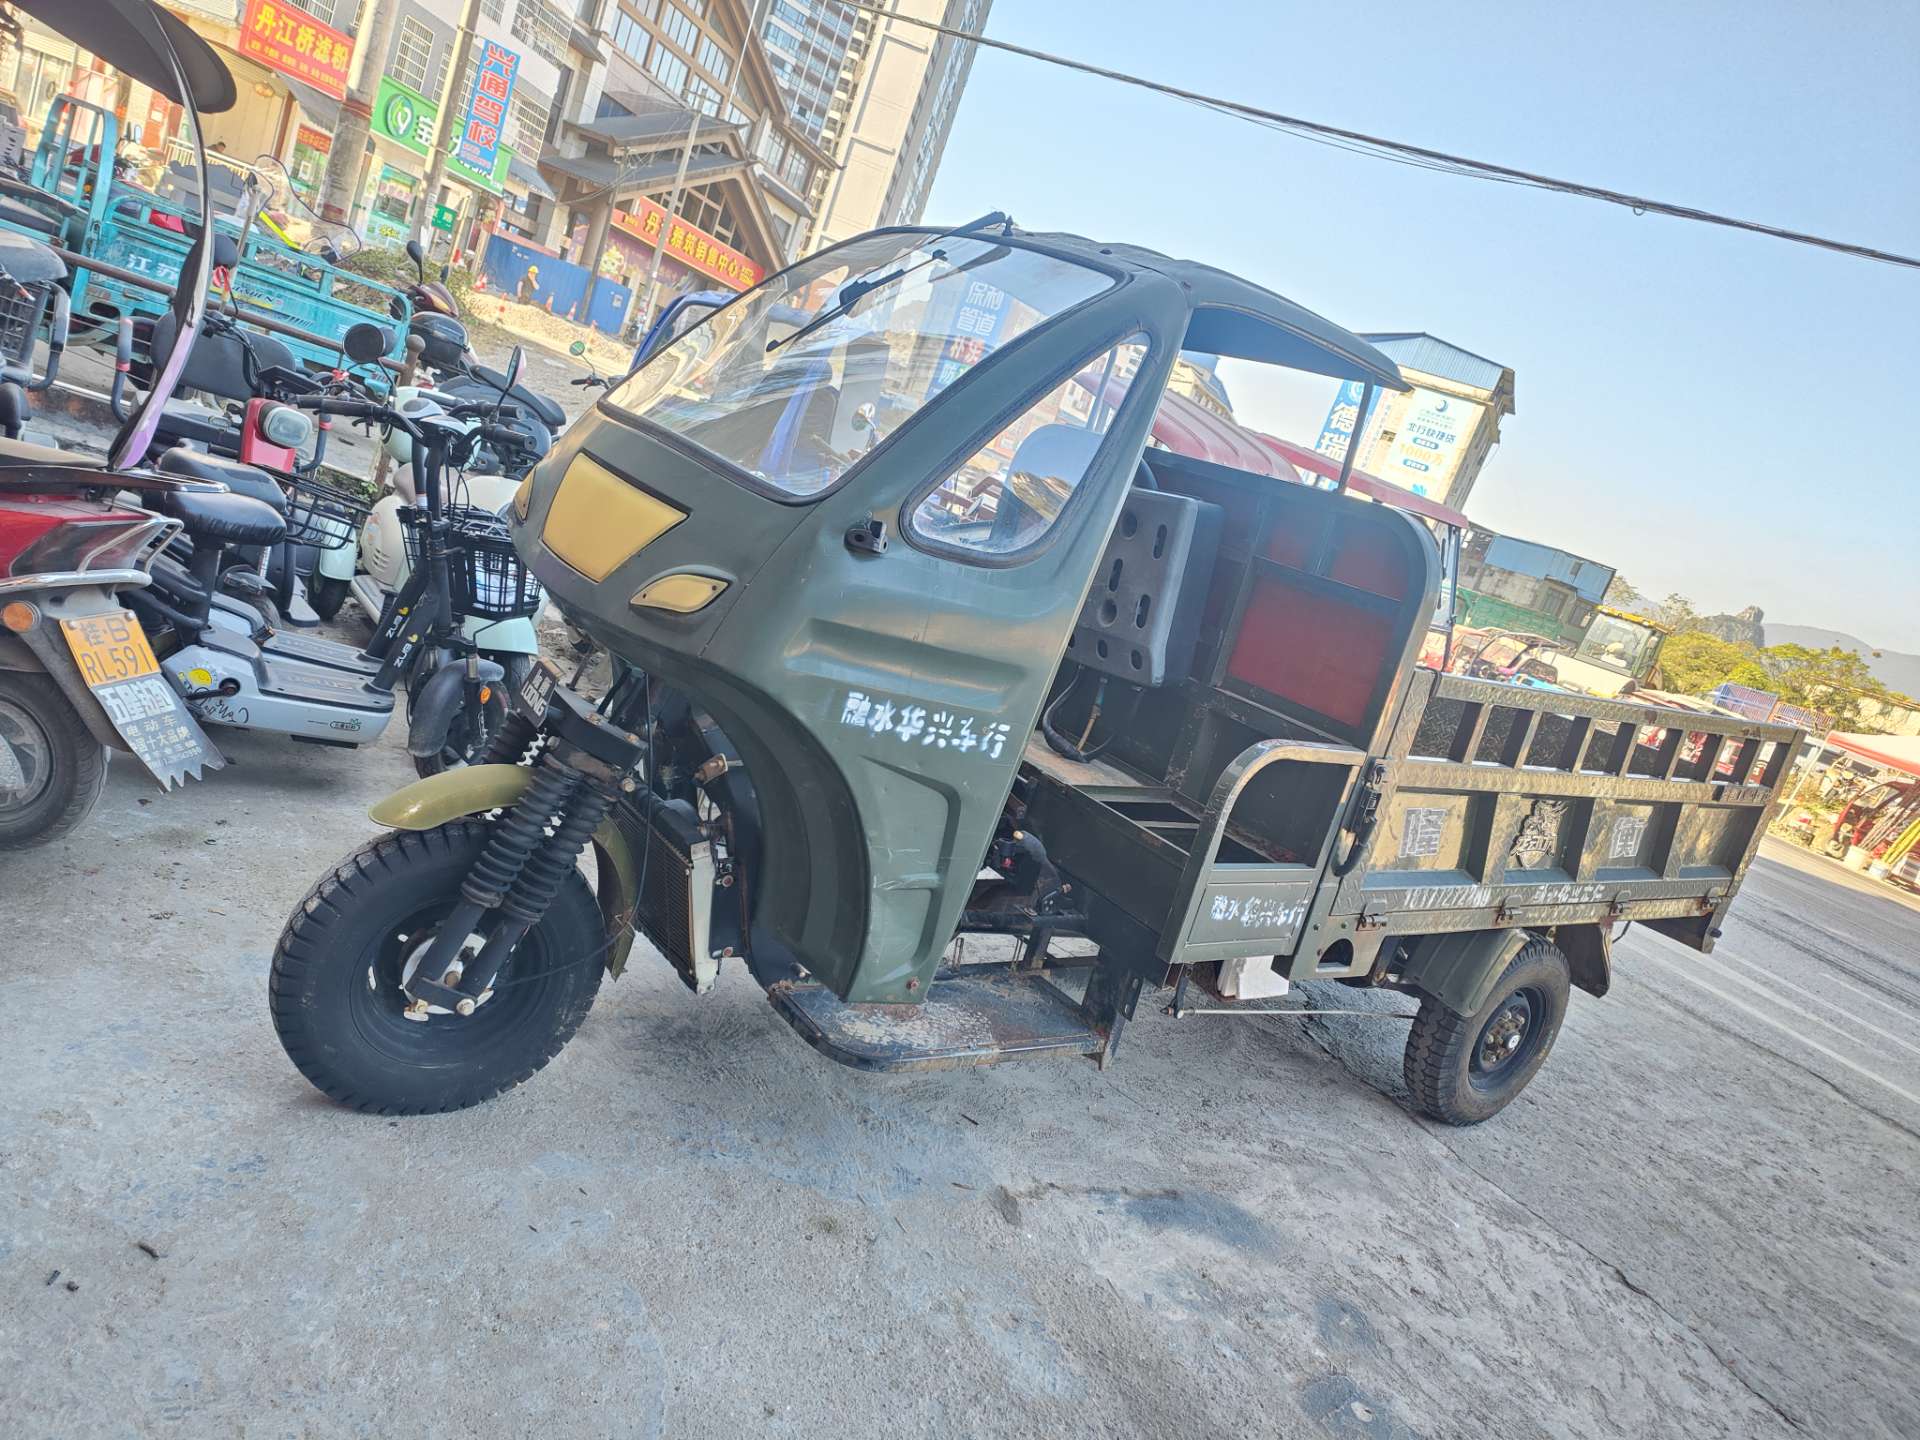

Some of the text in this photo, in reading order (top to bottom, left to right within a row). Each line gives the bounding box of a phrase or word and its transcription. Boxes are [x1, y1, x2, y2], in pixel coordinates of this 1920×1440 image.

[467, 44, 516, 151] 兴通驾校
[643, 210, 738, 279] 丹雅筑销售中心
[965, 281, 1005, 311] 保利
[956, 305, 997, 337] 管道
[80, 641, 154, 684] RL591
[126, 714, 177, 738] 电动车
[840, 691, 1011, 759] 融水华兴车行
